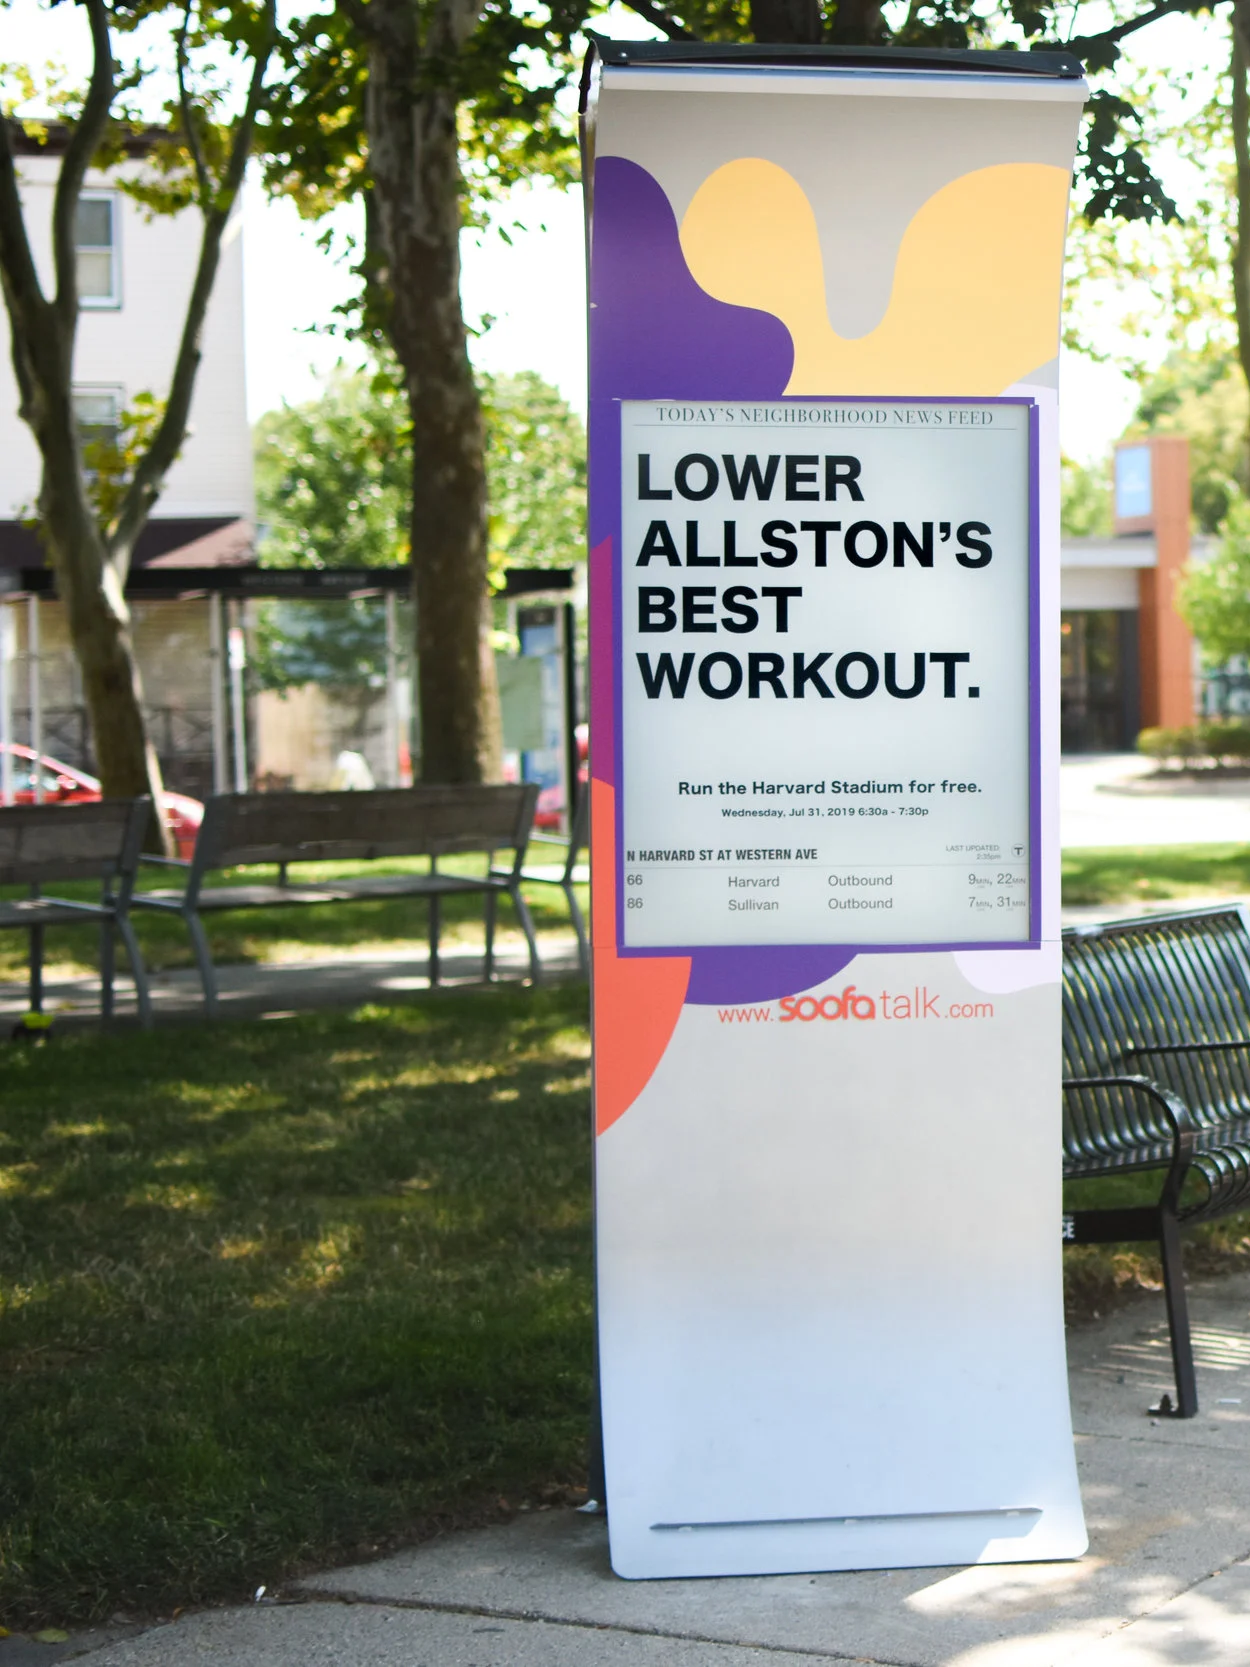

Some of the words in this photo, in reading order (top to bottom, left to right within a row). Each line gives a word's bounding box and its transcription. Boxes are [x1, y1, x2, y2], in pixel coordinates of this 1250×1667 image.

[657, 408, 733, 421] TODAY'S
[741, 409, 886, 423] NEIGHBORHOOD
[894, 410, 942, 423] NEWS
[949, 411, 992, 424] FEED
[638, 453, 864, 501] LOWER
[636, 520, 992, 568] ALLSTON'S
[638, 586, 802, 633] BEST
[636, 652, 979, 699] WORKOUT.
[679, 782, 712, 794] Run
[718, 782, 746, 794] the
[753, 781, 825, 794] Harvard
[832, 781, 902, 793] Stadium
[909, 780, 935, 793] for
[941, 780, 981, 792] free.
[721, 808, 786, 819] Wednesday,
[808, 808, 824, 816] 31,
[828, 808, 855, 816] 2019
[858, 808, 888, 816] 6:30a
[899, 807, 928, 816] 7:30p
[627, 851, 635, 861] N
[640, 850, 695, 861] HARVARD
[699, 850, 713, 860] ST
[718, 850, 731, 860] AT
[736, 849, 791, 860] WESTERN
[796, 849, 817, 859] AVE
[966, 844, 1000, 852] UPDATED
[627, 875, 642, 885] 66
[729, 876, 779, 887] Harvard
[828, 875, 892, 886] Outbound
[627, 898, 643, 909] 86
[729, 899, 778, 911] Sullivan
[828, 898, 892, 909] Outbound
